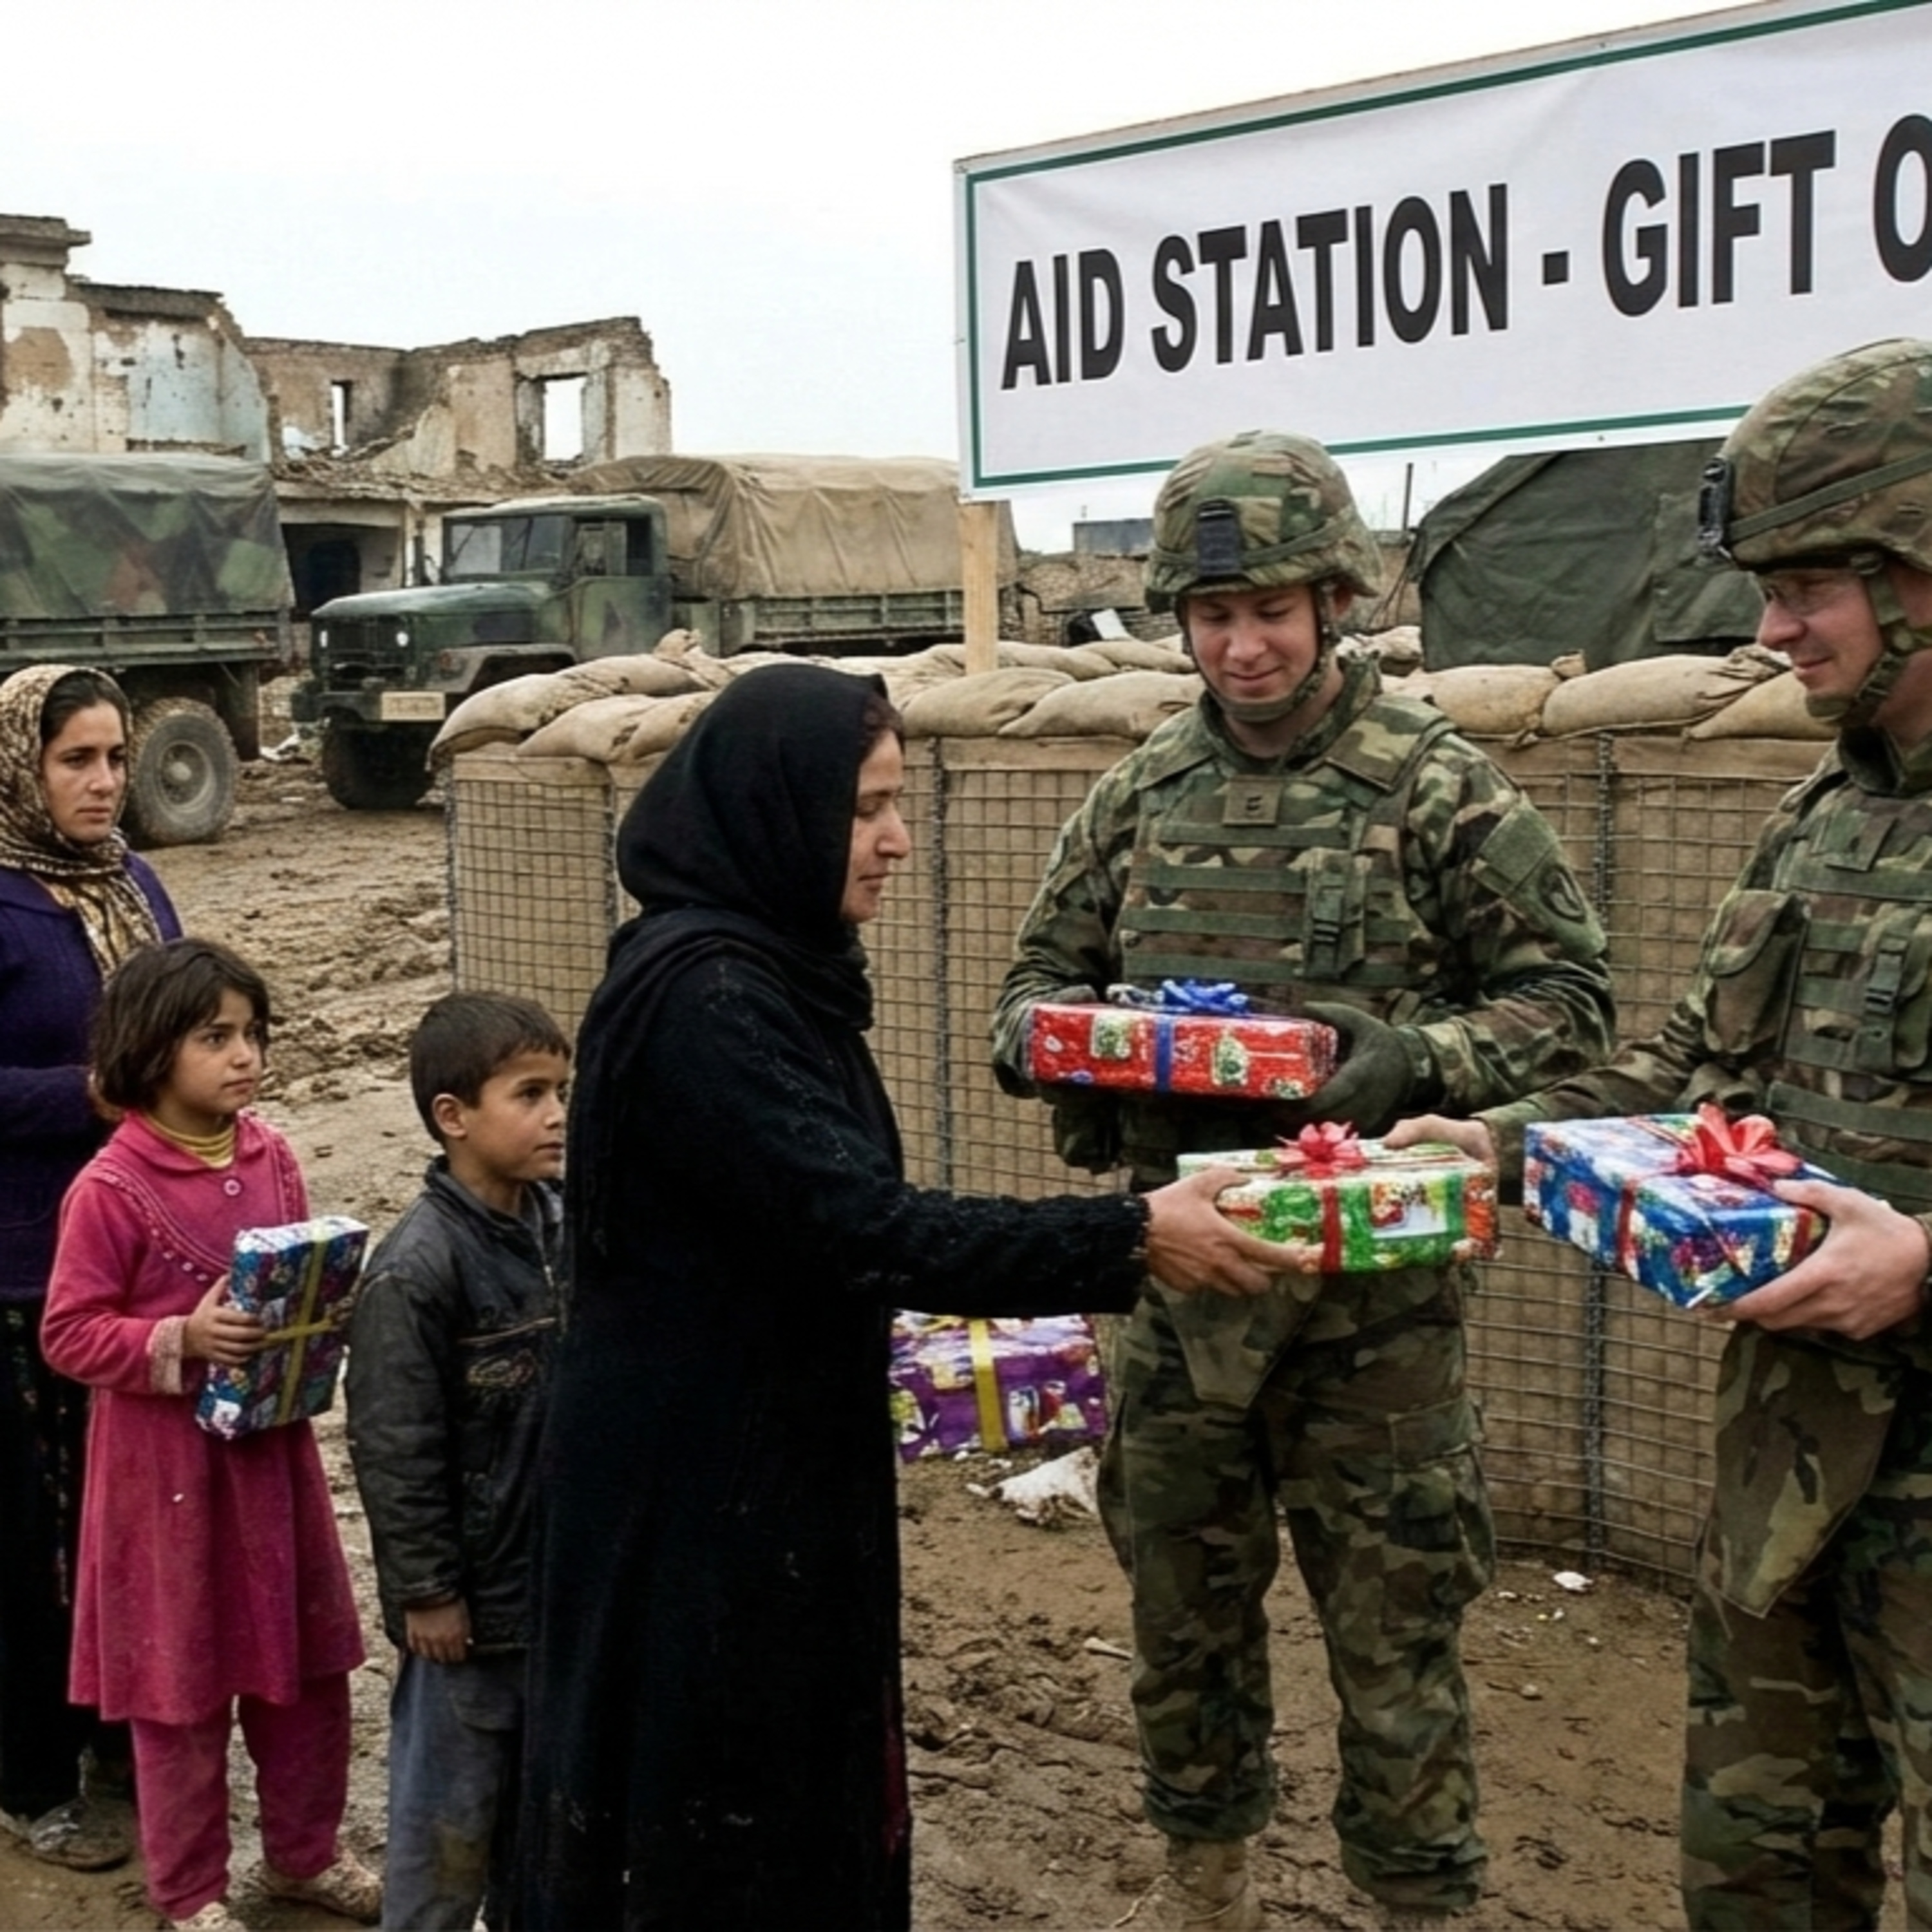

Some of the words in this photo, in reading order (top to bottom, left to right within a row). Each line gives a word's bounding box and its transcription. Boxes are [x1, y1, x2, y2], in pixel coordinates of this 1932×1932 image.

[1001, 249, 1124, 390] AID
[1151, 183, 1508, 372] STATION
[1542, 251, 1569, 285] -
[1602, 130, 1836, 317] GIFT
[1873, 115, 1932, 282] O
